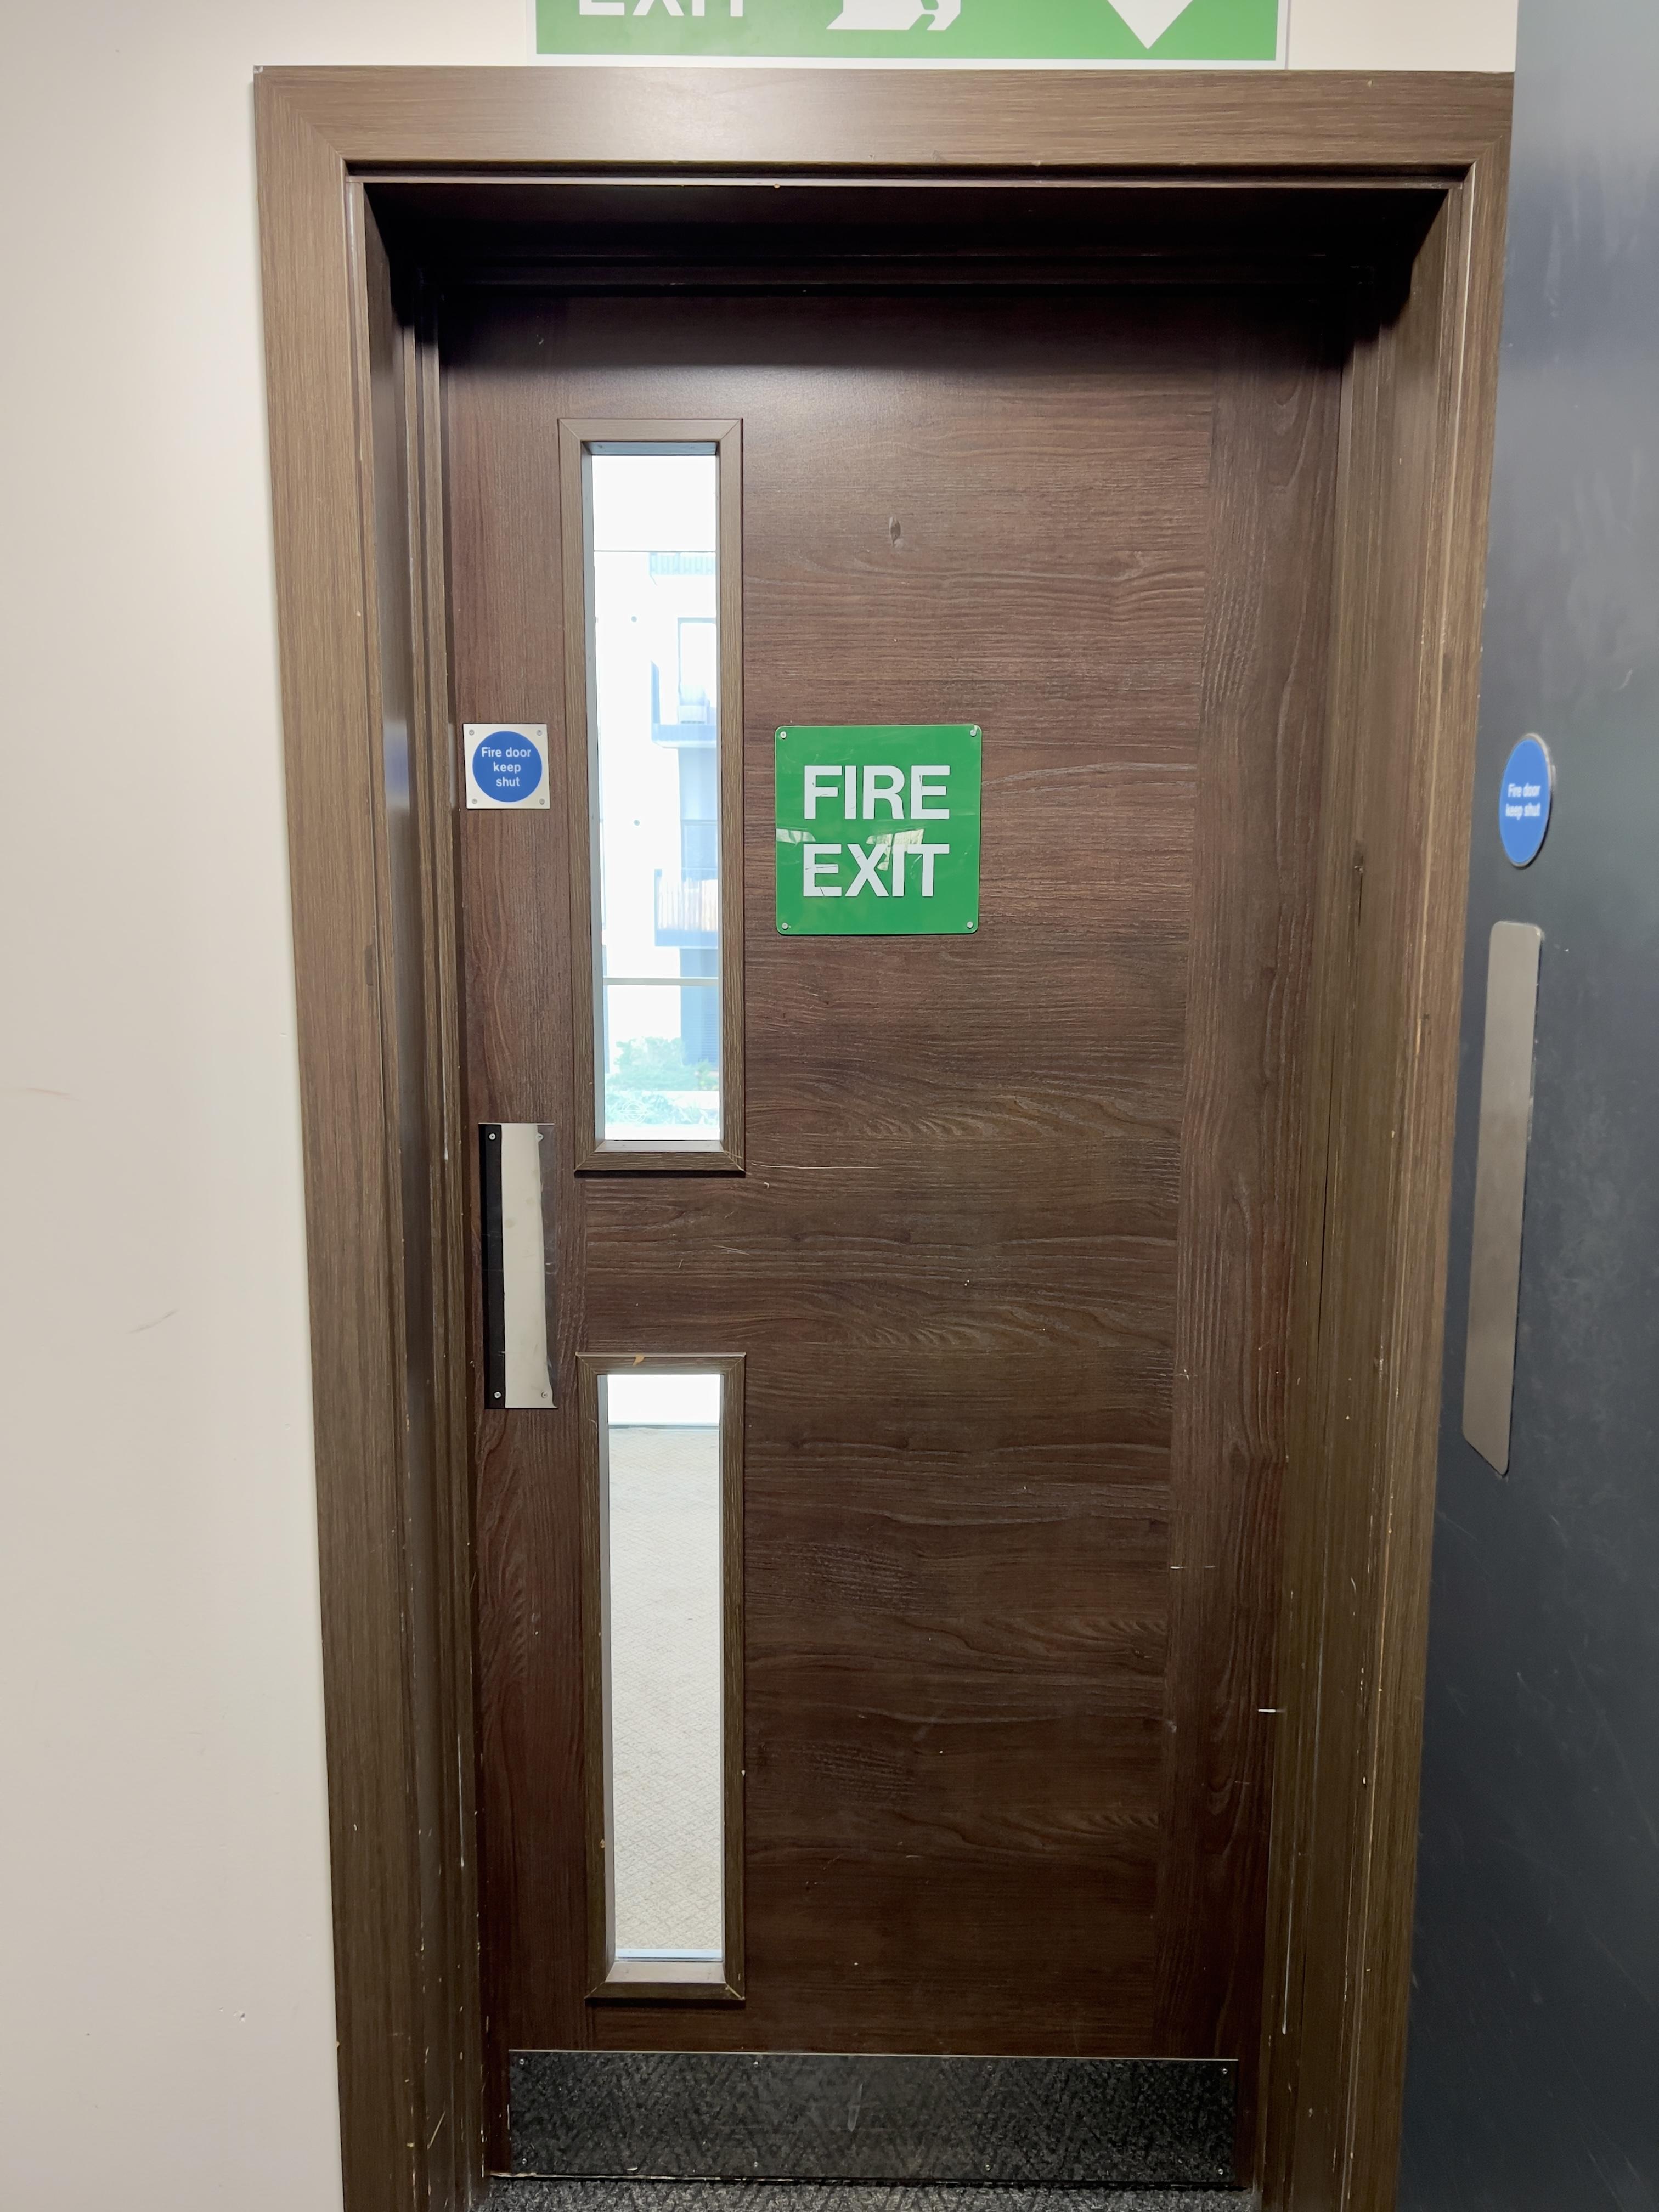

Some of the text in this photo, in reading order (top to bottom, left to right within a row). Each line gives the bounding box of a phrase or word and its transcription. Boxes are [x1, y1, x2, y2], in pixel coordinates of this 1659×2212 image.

[481, 747, 532, 758] Fire door
[493, 761, 521, 774] keep
[496, 776, 520, 787] shut
[804, 765, 950, 820] FIRE
[1508, 782, 1541, 798] Fire door
[803, 843, 950, 898] EXIT
